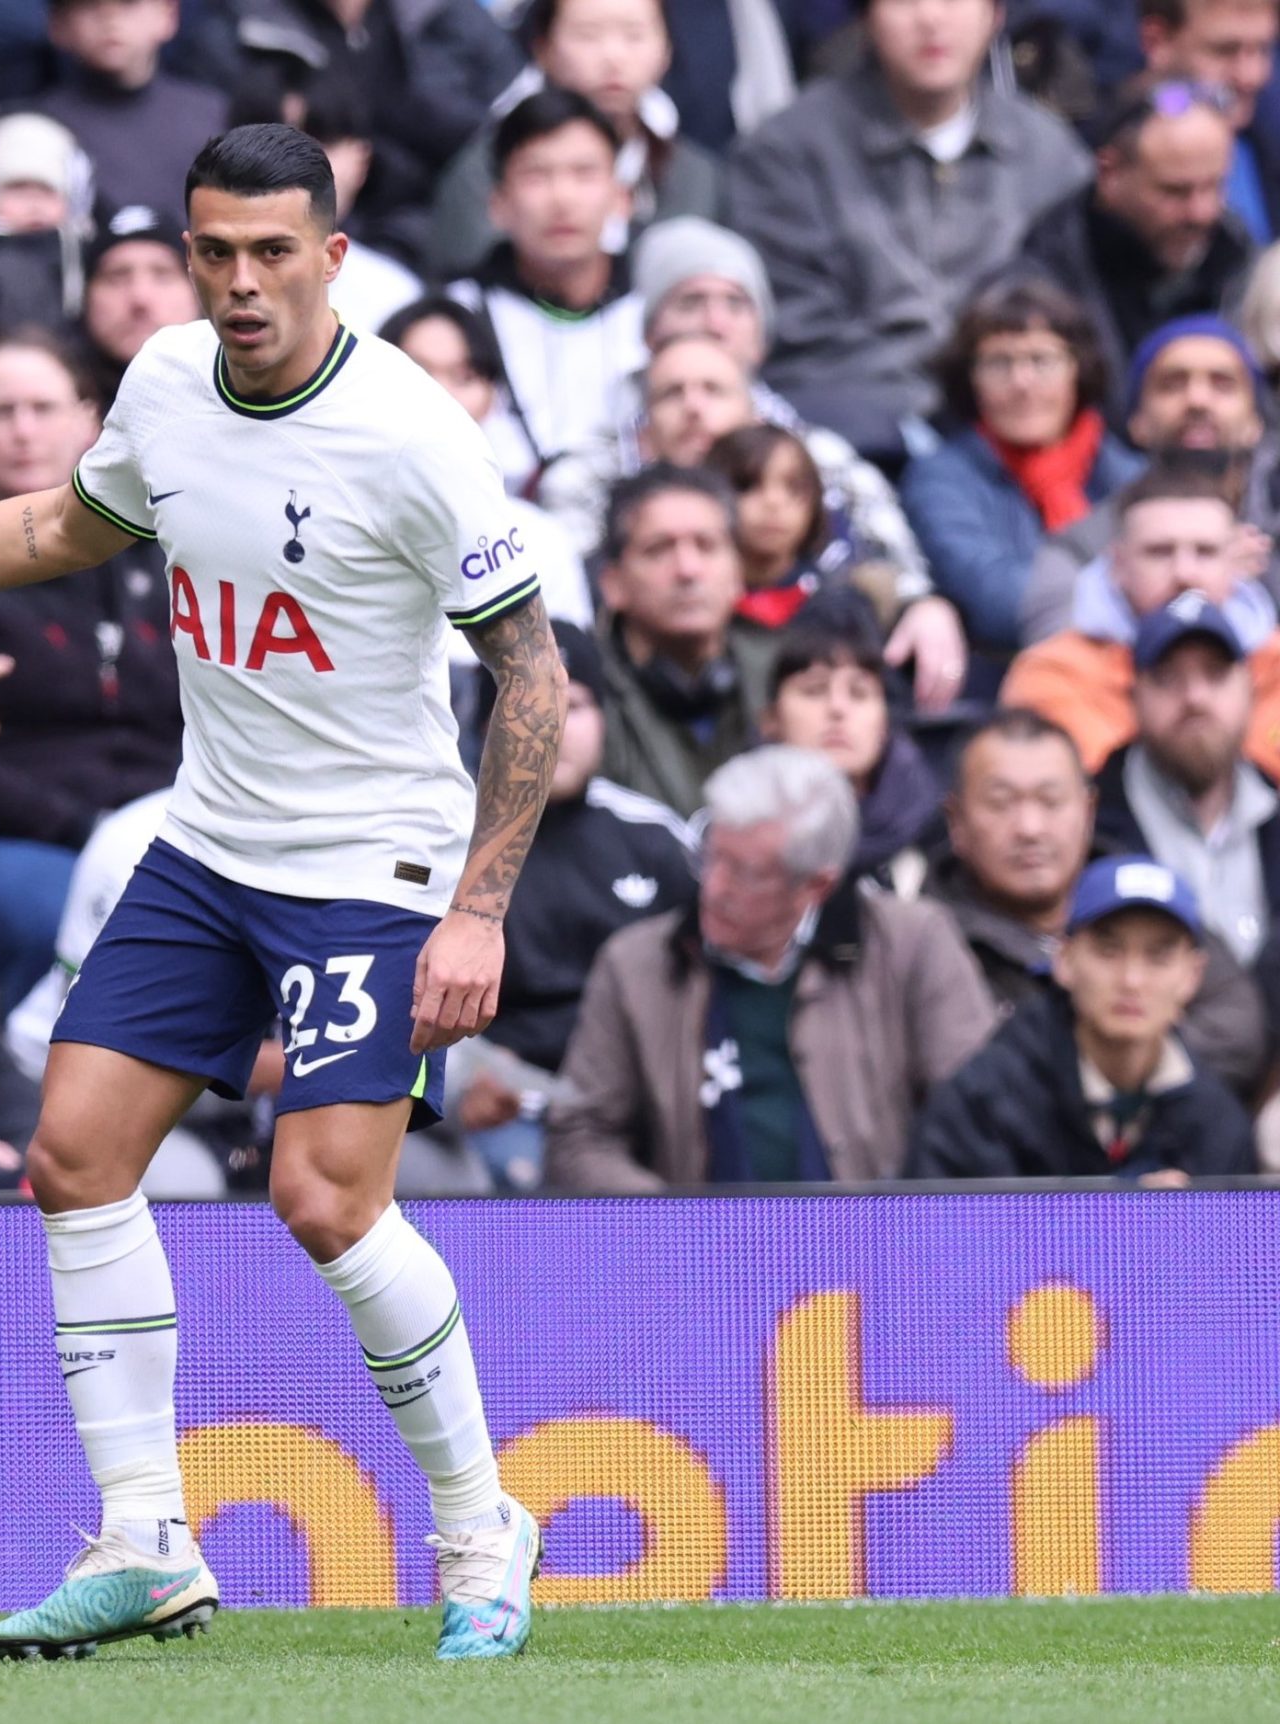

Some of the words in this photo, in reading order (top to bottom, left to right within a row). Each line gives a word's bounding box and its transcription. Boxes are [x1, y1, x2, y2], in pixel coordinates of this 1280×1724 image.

[460, 526, 525, 580] cinc
[170, 565, 336, 673] AIA
[279, 954, 378, 1054] 23
[377, 1365, 441, 1394] PURS
